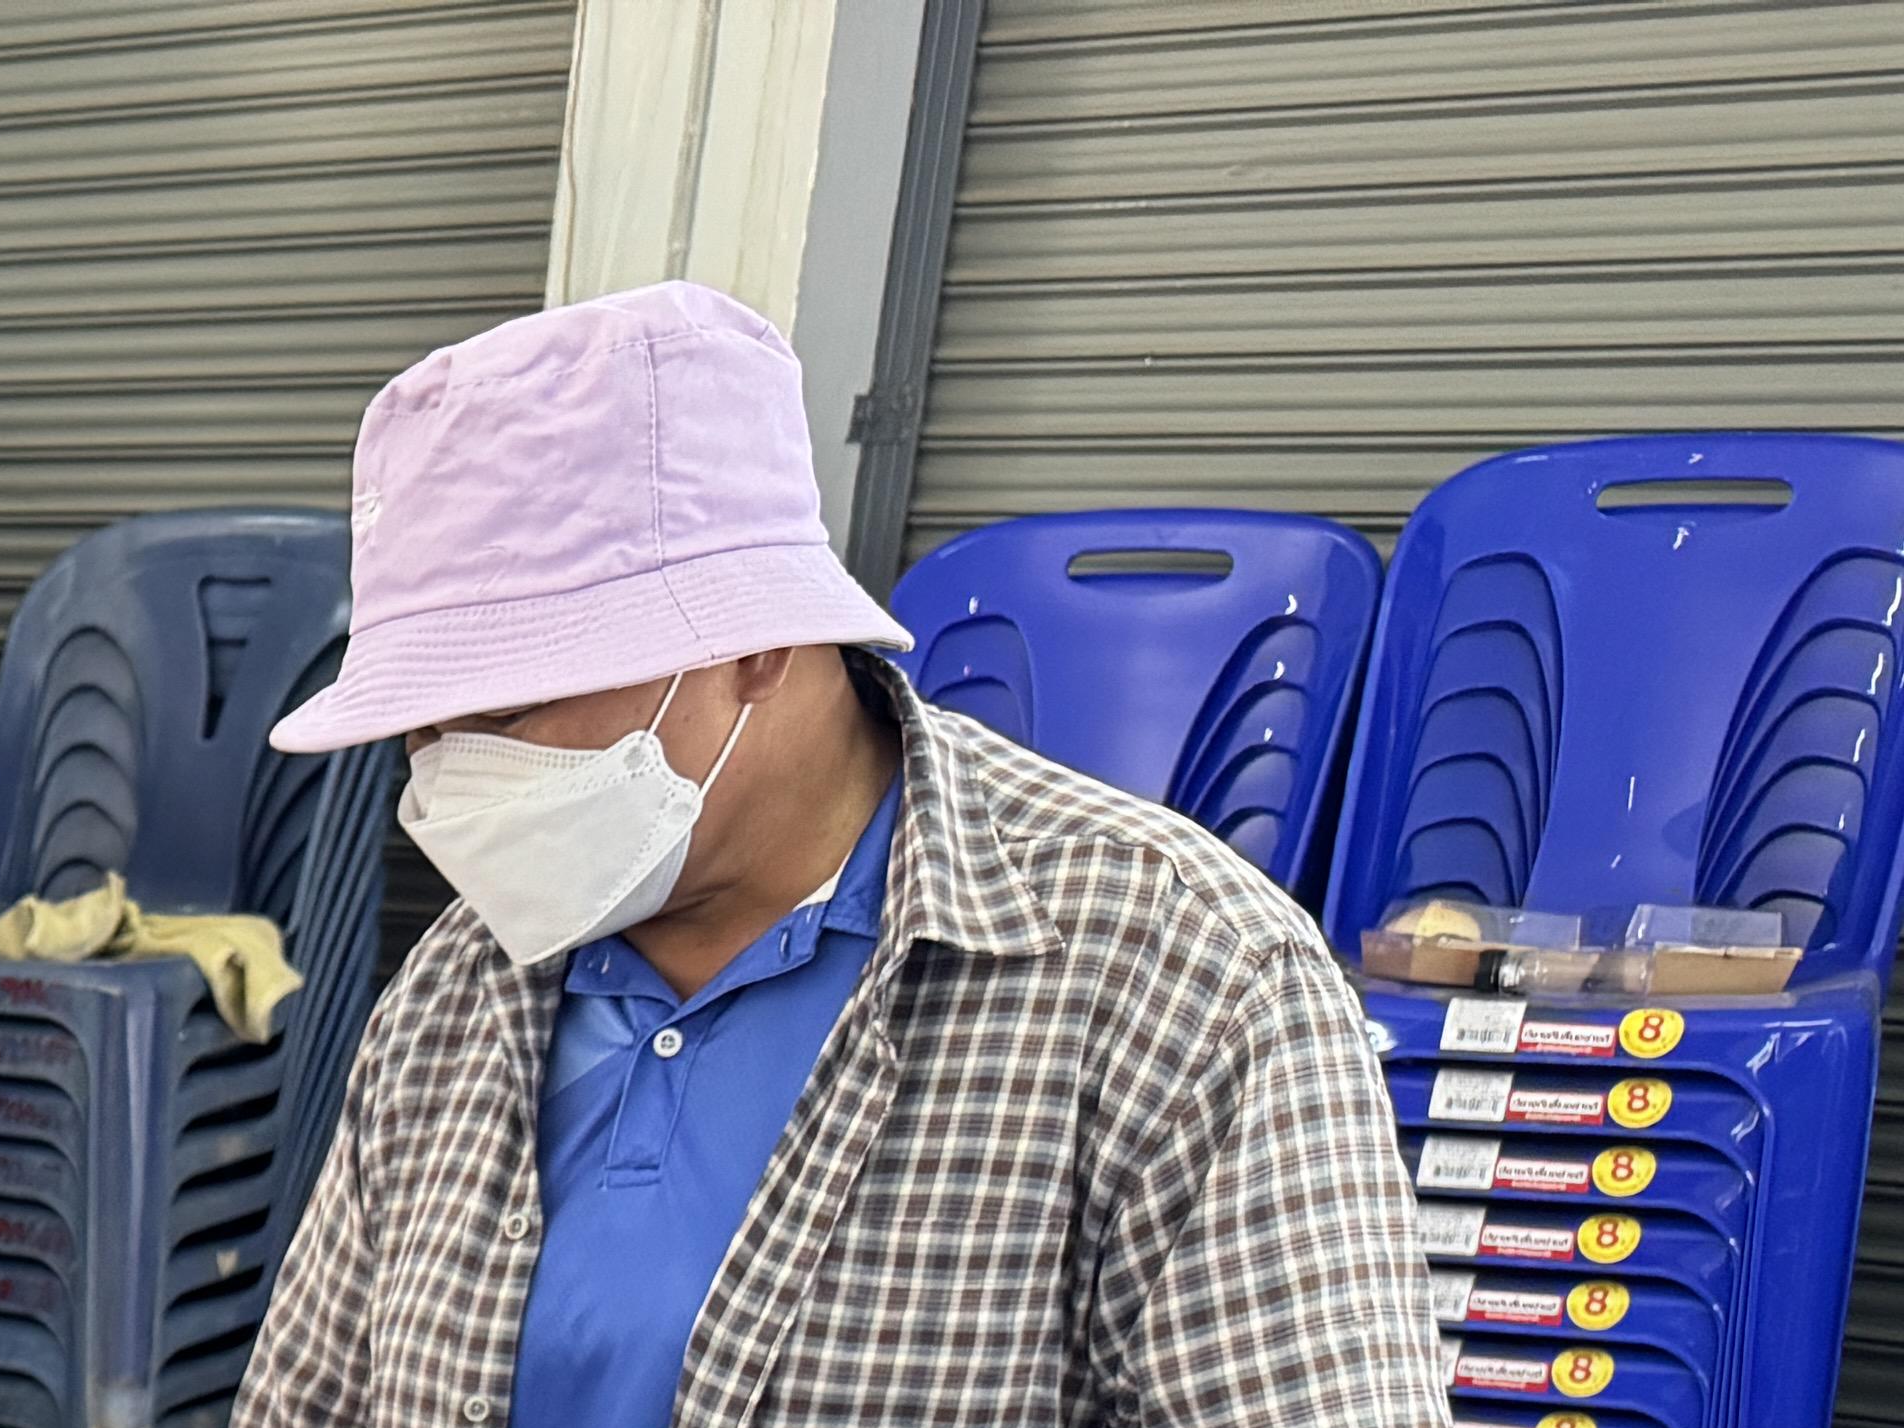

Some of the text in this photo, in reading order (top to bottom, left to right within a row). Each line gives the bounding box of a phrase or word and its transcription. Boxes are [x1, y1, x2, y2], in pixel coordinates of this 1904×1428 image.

[1638, 1014, 1665, 1042] 8
[1627, 1083, 1651, 1113] 8
[1611, 1151, 1634, 1182] 8
[1596, 1218, 1619, 1248] 8
[1584, 1286, 1609, 1316] 8
[1569, 1354, 1593, 1384] 8
